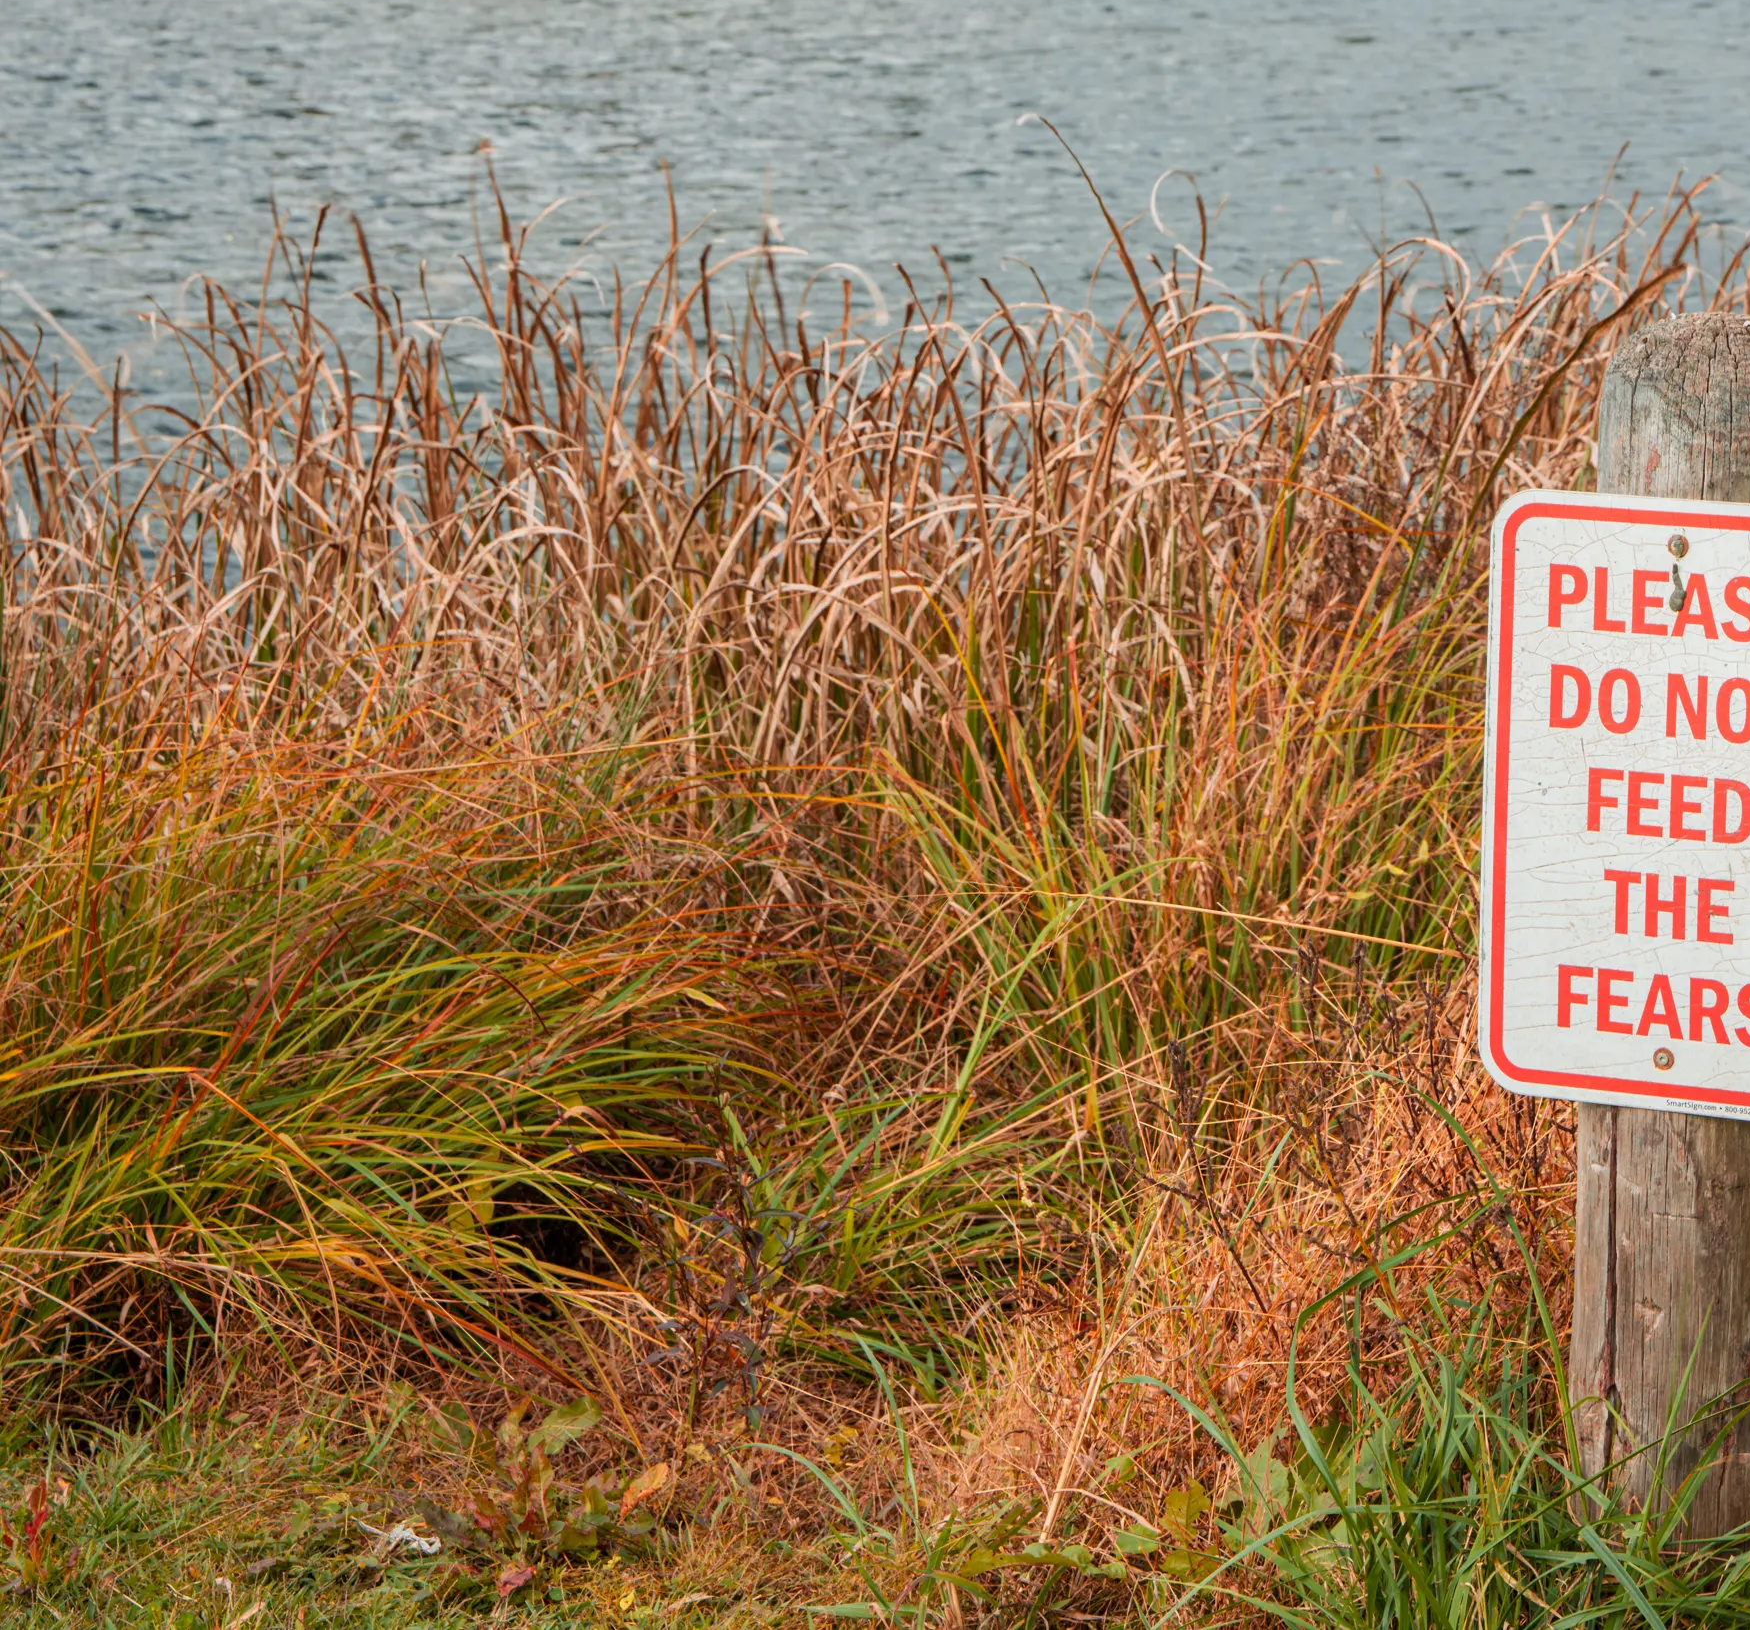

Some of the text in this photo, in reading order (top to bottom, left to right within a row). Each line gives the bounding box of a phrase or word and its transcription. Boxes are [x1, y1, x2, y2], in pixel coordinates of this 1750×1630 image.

[1549, 663, 1642, 735] DO
[1603, 868, 1736, 946] THE
[1666, 1099, 1717, 1111] SmartSign.com
